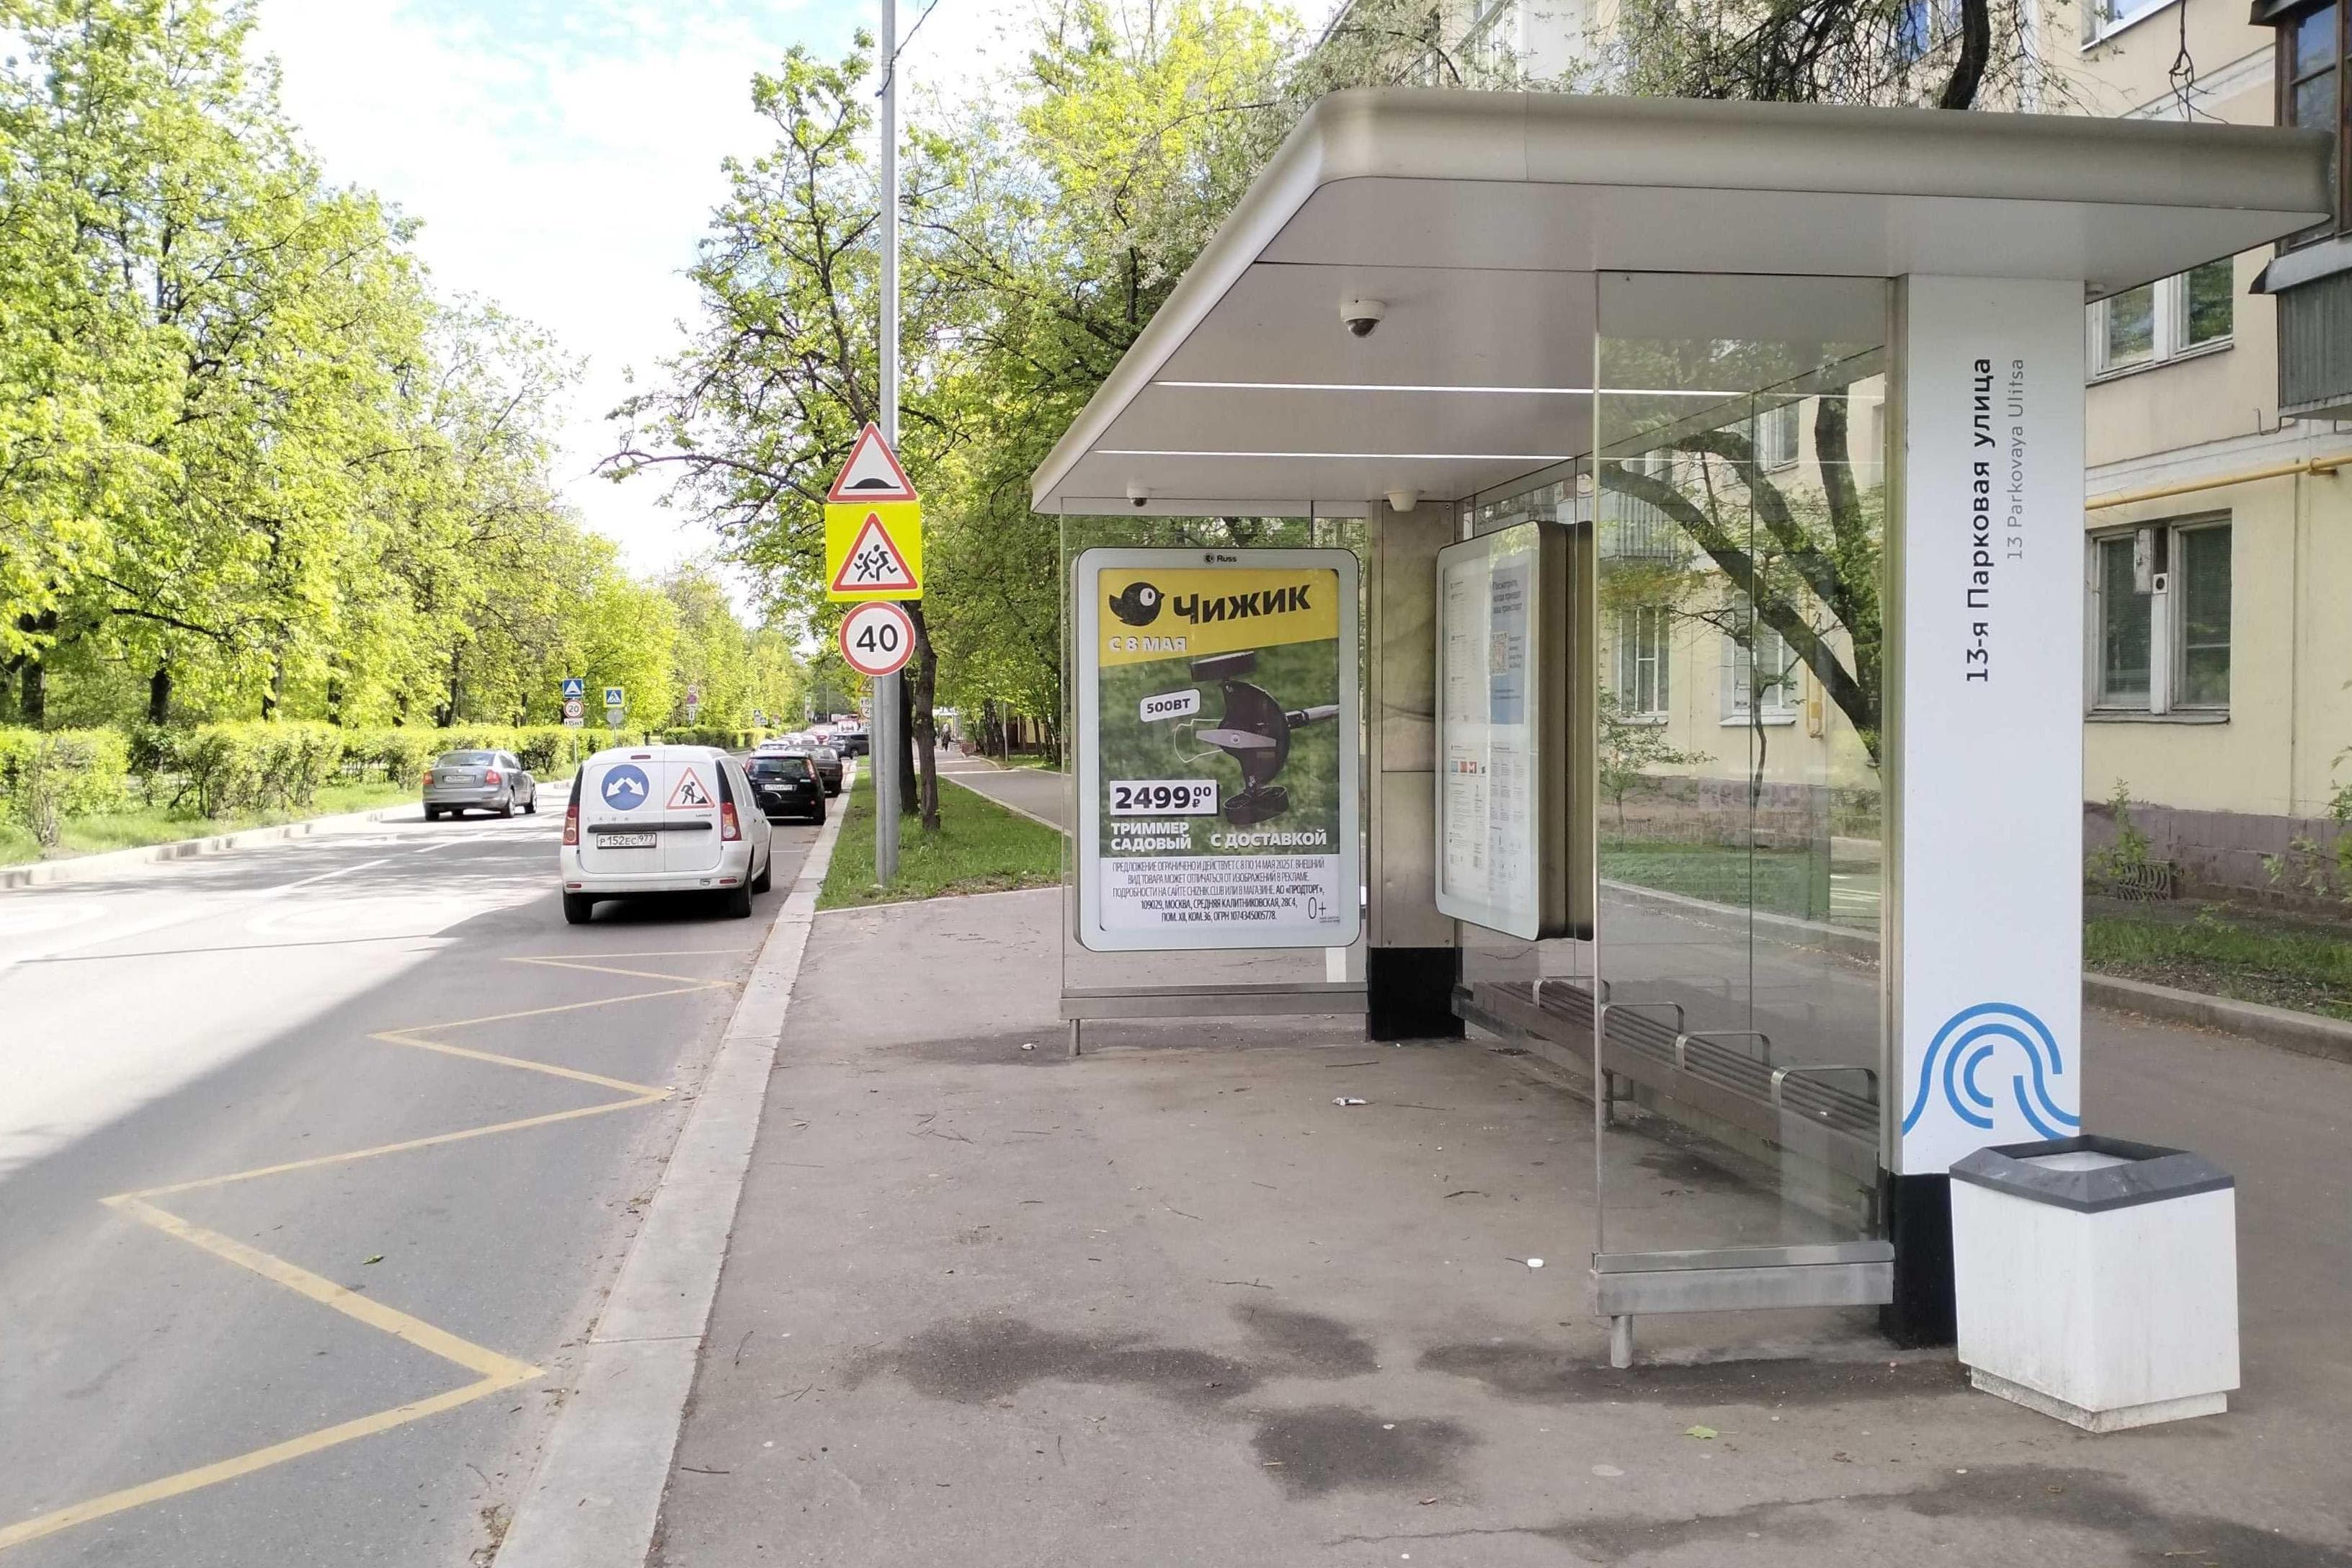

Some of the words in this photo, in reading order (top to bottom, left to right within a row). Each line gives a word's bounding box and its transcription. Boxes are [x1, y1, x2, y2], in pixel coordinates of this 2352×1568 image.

[2007, 359, 2023, 417] Ulitsa
[1974, 358, 1995, 447] улица
[2007, 426, 2026, 527] Parkovaya
[1967, 461, 1995, 608] Парковая
[2008, 536, 2023, 560] 13
[857, 624, 898, 652] 40
[1109, 636, 1121, 652] С
[1126, 636, 1139, 652] 8
[1143, 636, 1188, 652] МАЯ
[1966, 621, 1989, 682] 13-я
[1146, 698, 1190, 714] 500ВТ
[1115, 786, 1190, 809] 2499
[1193, 787, 1211, 797] 00
[1111, 822, 1189, 834] ТРИММЕР
[1110, 834, 1192, 852] САДОВЫЙ
[1211, 833, 1221, 847] С
[1225, 829, 1327, 849] ДОСТАВКОЙ
[1113, 862, 1157, 872] ПРЕДЛОЖЕНИЕ
[1202, 860, 1235, 871] ДЕЙСТВУЕТ
[1262, 860, 1275, 870] МАЯ
[1296, 857, 1324, 869] ВНЕШНИЙ
[1128, 875, 1141, 885] ВИД
[1141, 874, 1164, 885] ТОВАРА
[1164, 874, 1185, 883] МОЖЕТ
[1187, 873, 1223, 883] ОТЛИЧАТЬСЯ
[1232, 870, 1276, 882] ИЗОБРАЖЕНИЙ
[1113, 887, 1158, 899] ПОДРОБНОСТИ
[1158, 887, 1167, 896] НА
[1167, 885, 1187, 896] САЙТЕ
[1225, 886, 1237, 895] ИЛИ
[1276, 885, 1284, 894] АО
[1141, 900, 1164, 911] 109029,
[1165, 899, 1193, 910] МОСКВА,
[1193, 899, 1221, 910] СРЕДНЯЯ
[1222, 898, 1280, 909] КАЛИТНИКОВСКАЯ,
[1308, 896, 1327, 919] 0+
[1213, 911, 1229, 921] ОГРН
